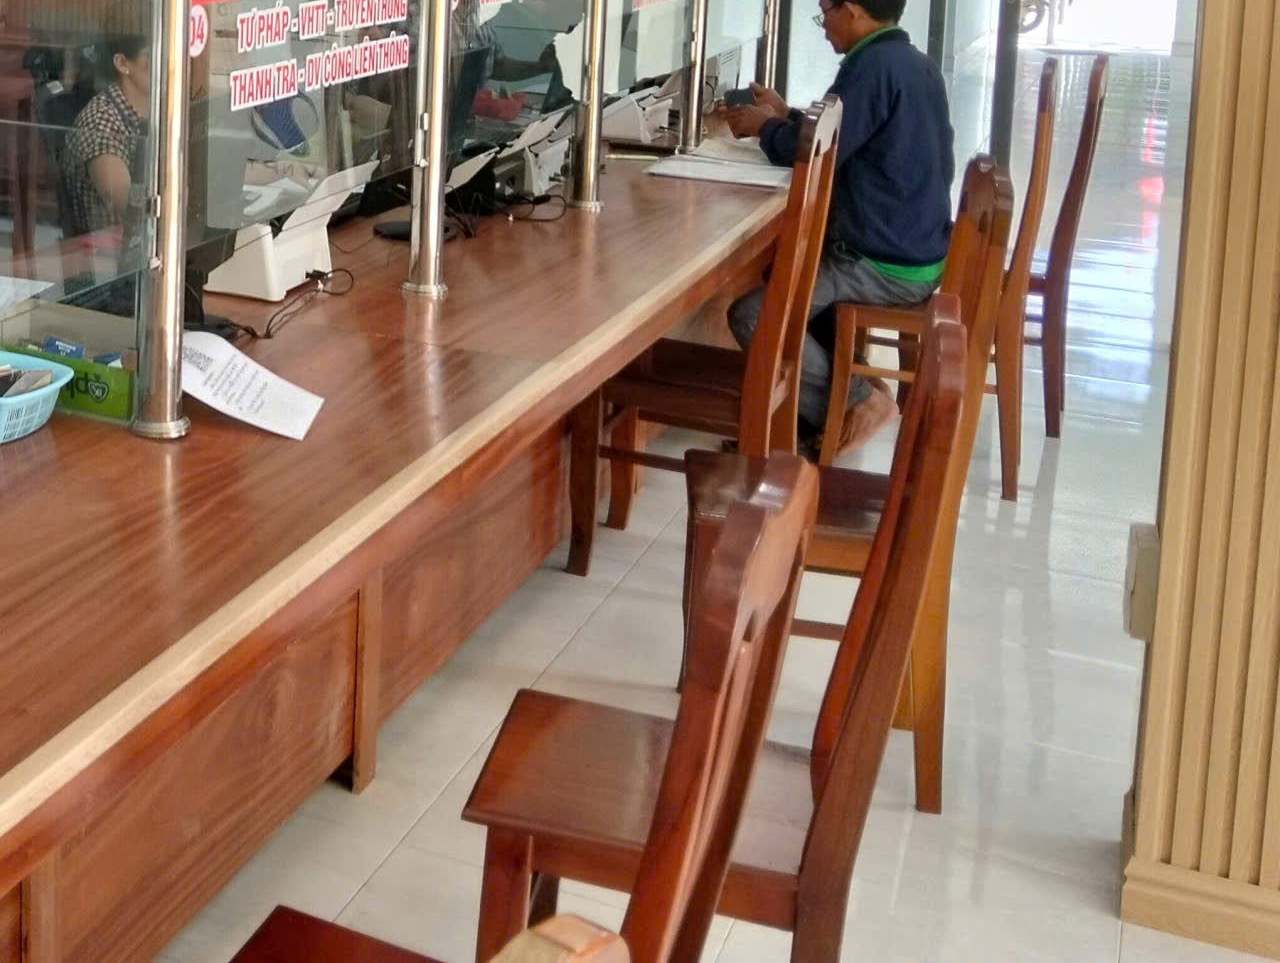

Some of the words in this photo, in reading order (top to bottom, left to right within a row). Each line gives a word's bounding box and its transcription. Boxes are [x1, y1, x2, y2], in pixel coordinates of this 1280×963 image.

[238, 8, 256, 51] TƯ
[256, 0, 290, 48] PHÁP
[300, 1, 327, 38] VHTT
[231, 66, 274, 109] THANH
[275, 61, 297, 98] TRA
[306, 54, 322, 90] DV
[323, 43, 352, 86] CÔNG
[353, 36, 376, 79] LIÊN
[377, 31, 408, 72] THÔNG
